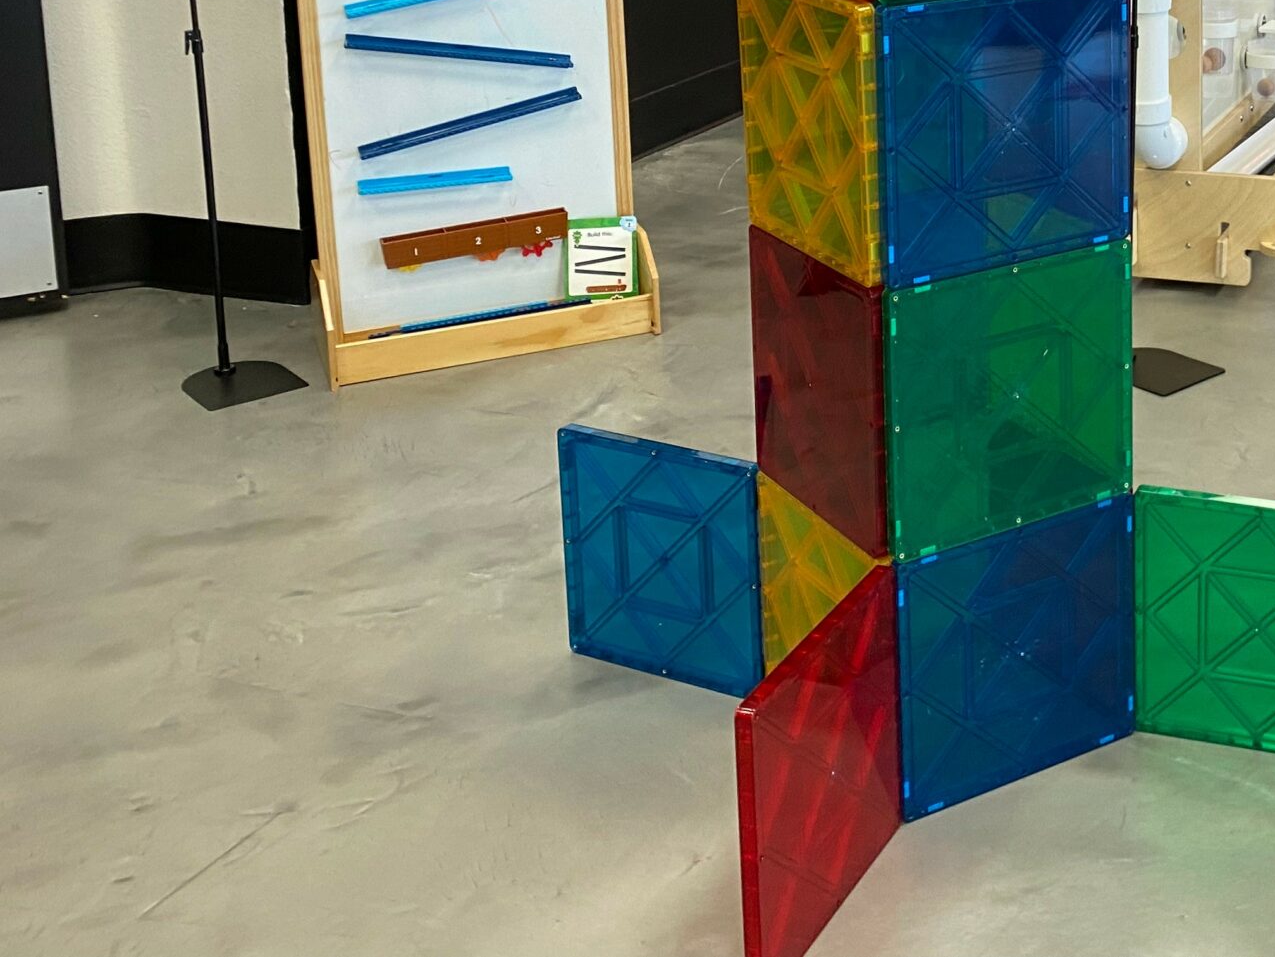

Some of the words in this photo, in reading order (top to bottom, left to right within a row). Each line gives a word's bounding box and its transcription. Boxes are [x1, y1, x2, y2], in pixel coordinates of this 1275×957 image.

[535, 226, 542, 235] 3
[475, 237, 482, 245] 2
[414, 247, 419, 256] 1
